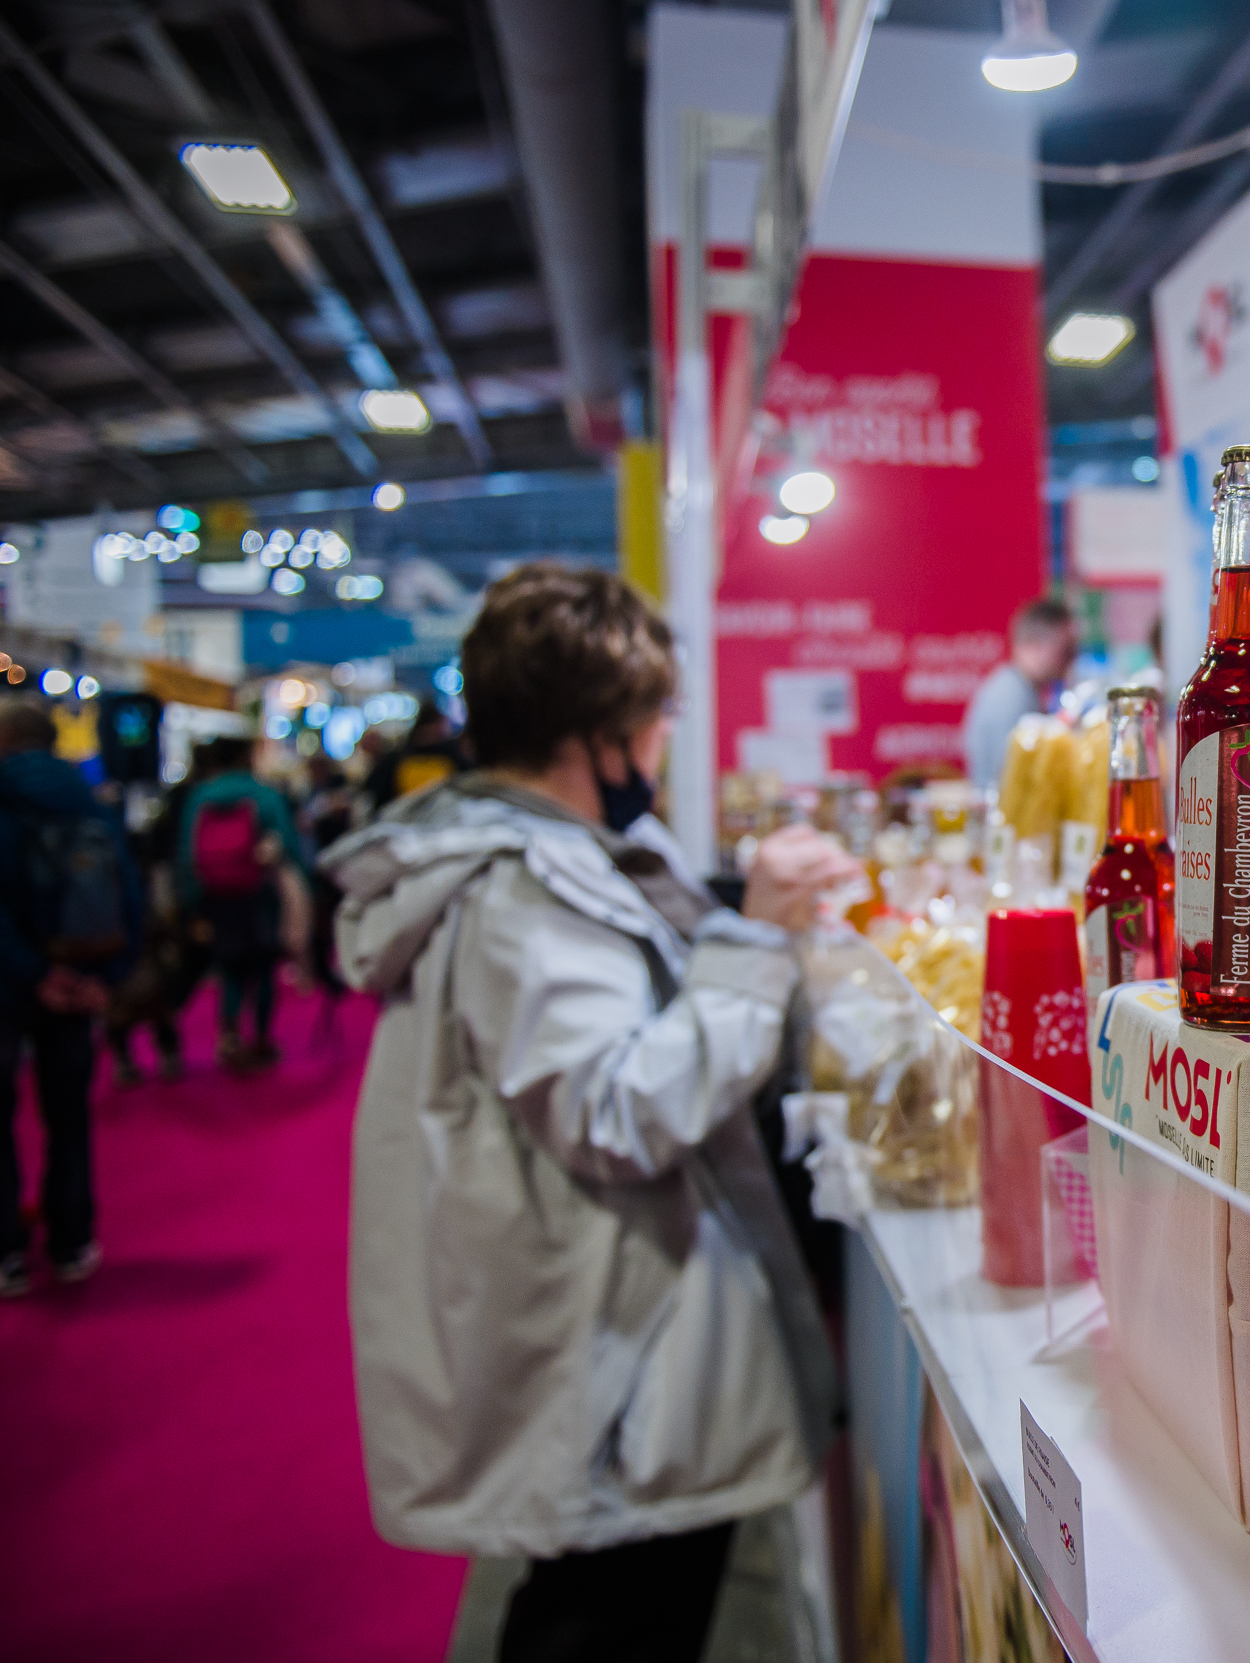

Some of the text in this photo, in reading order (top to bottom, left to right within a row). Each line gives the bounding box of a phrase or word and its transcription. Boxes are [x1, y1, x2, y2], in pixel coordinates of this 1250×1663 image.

[1221, 905, 1250, 927] du
[1145, 1031, 1221, 1150] MOSL
[1190, 1147, 1215, 1179] LIMITE
